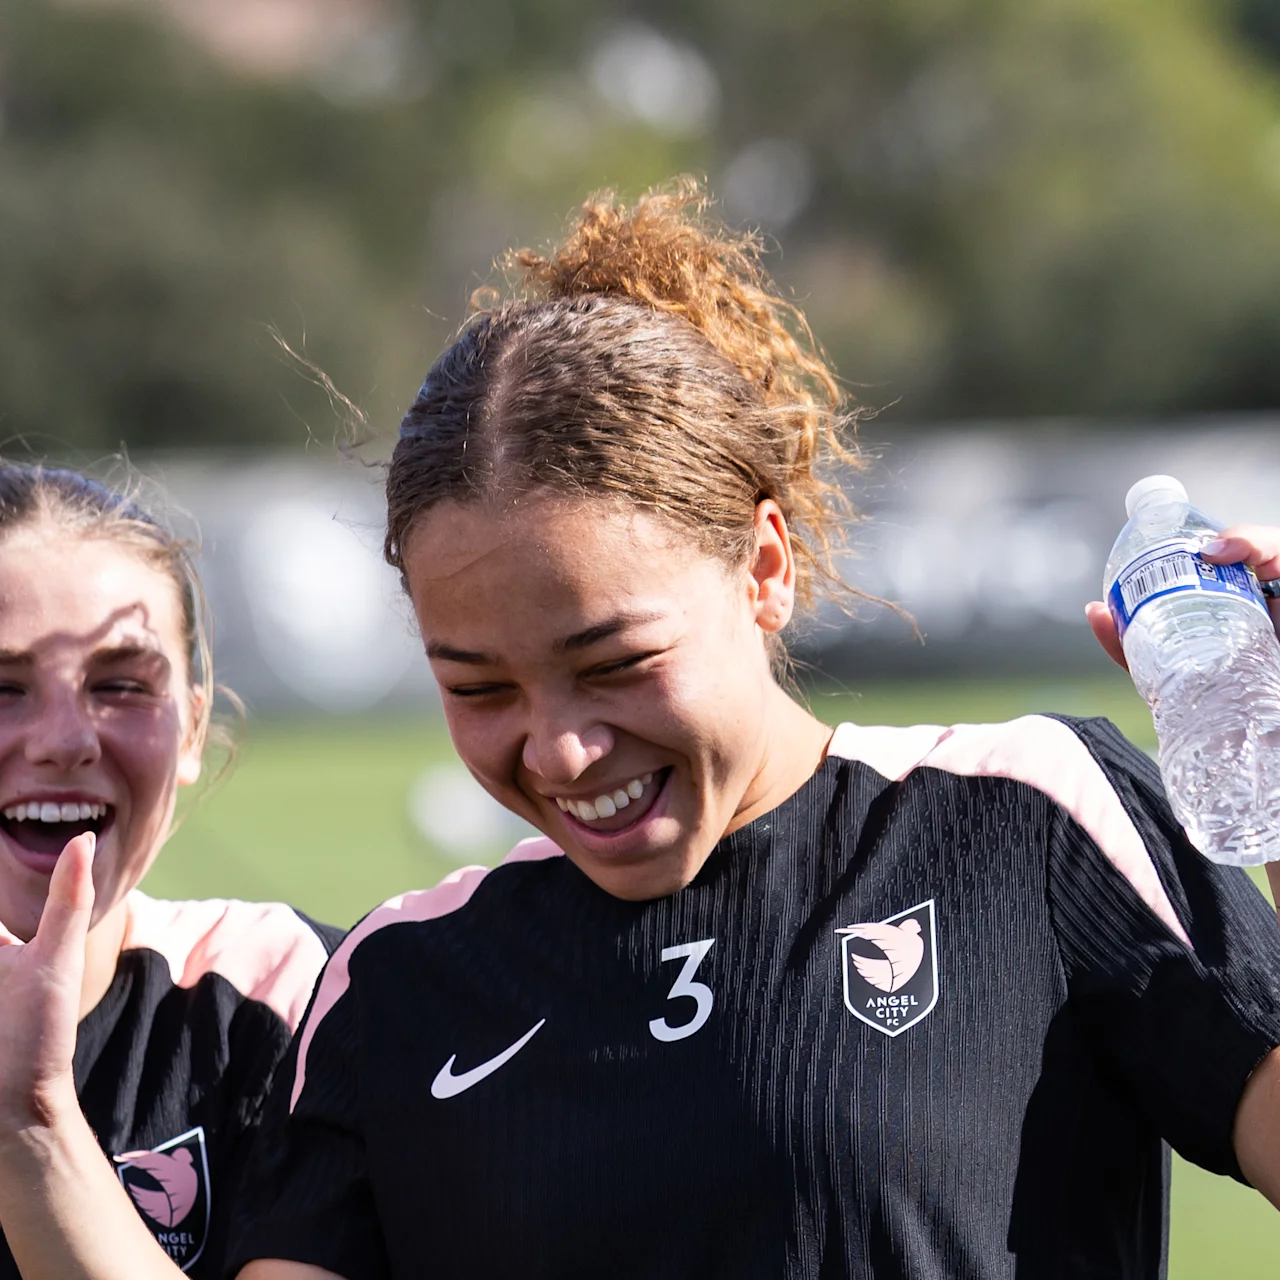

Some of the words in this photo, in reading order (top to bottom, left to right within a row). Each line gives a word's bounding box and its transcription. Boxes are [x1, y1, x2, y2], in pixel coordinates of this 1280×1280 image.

[648, 938, 716, 1042] 3
[865, 995, 919, 1008] ANGEL
[875, 1006, 909, 1018] CITY
[886, 1018, 900, 1026] FC
[158, 1232, 195, 1245] NGEL
[161, 1245, 188, 1257] ITY
